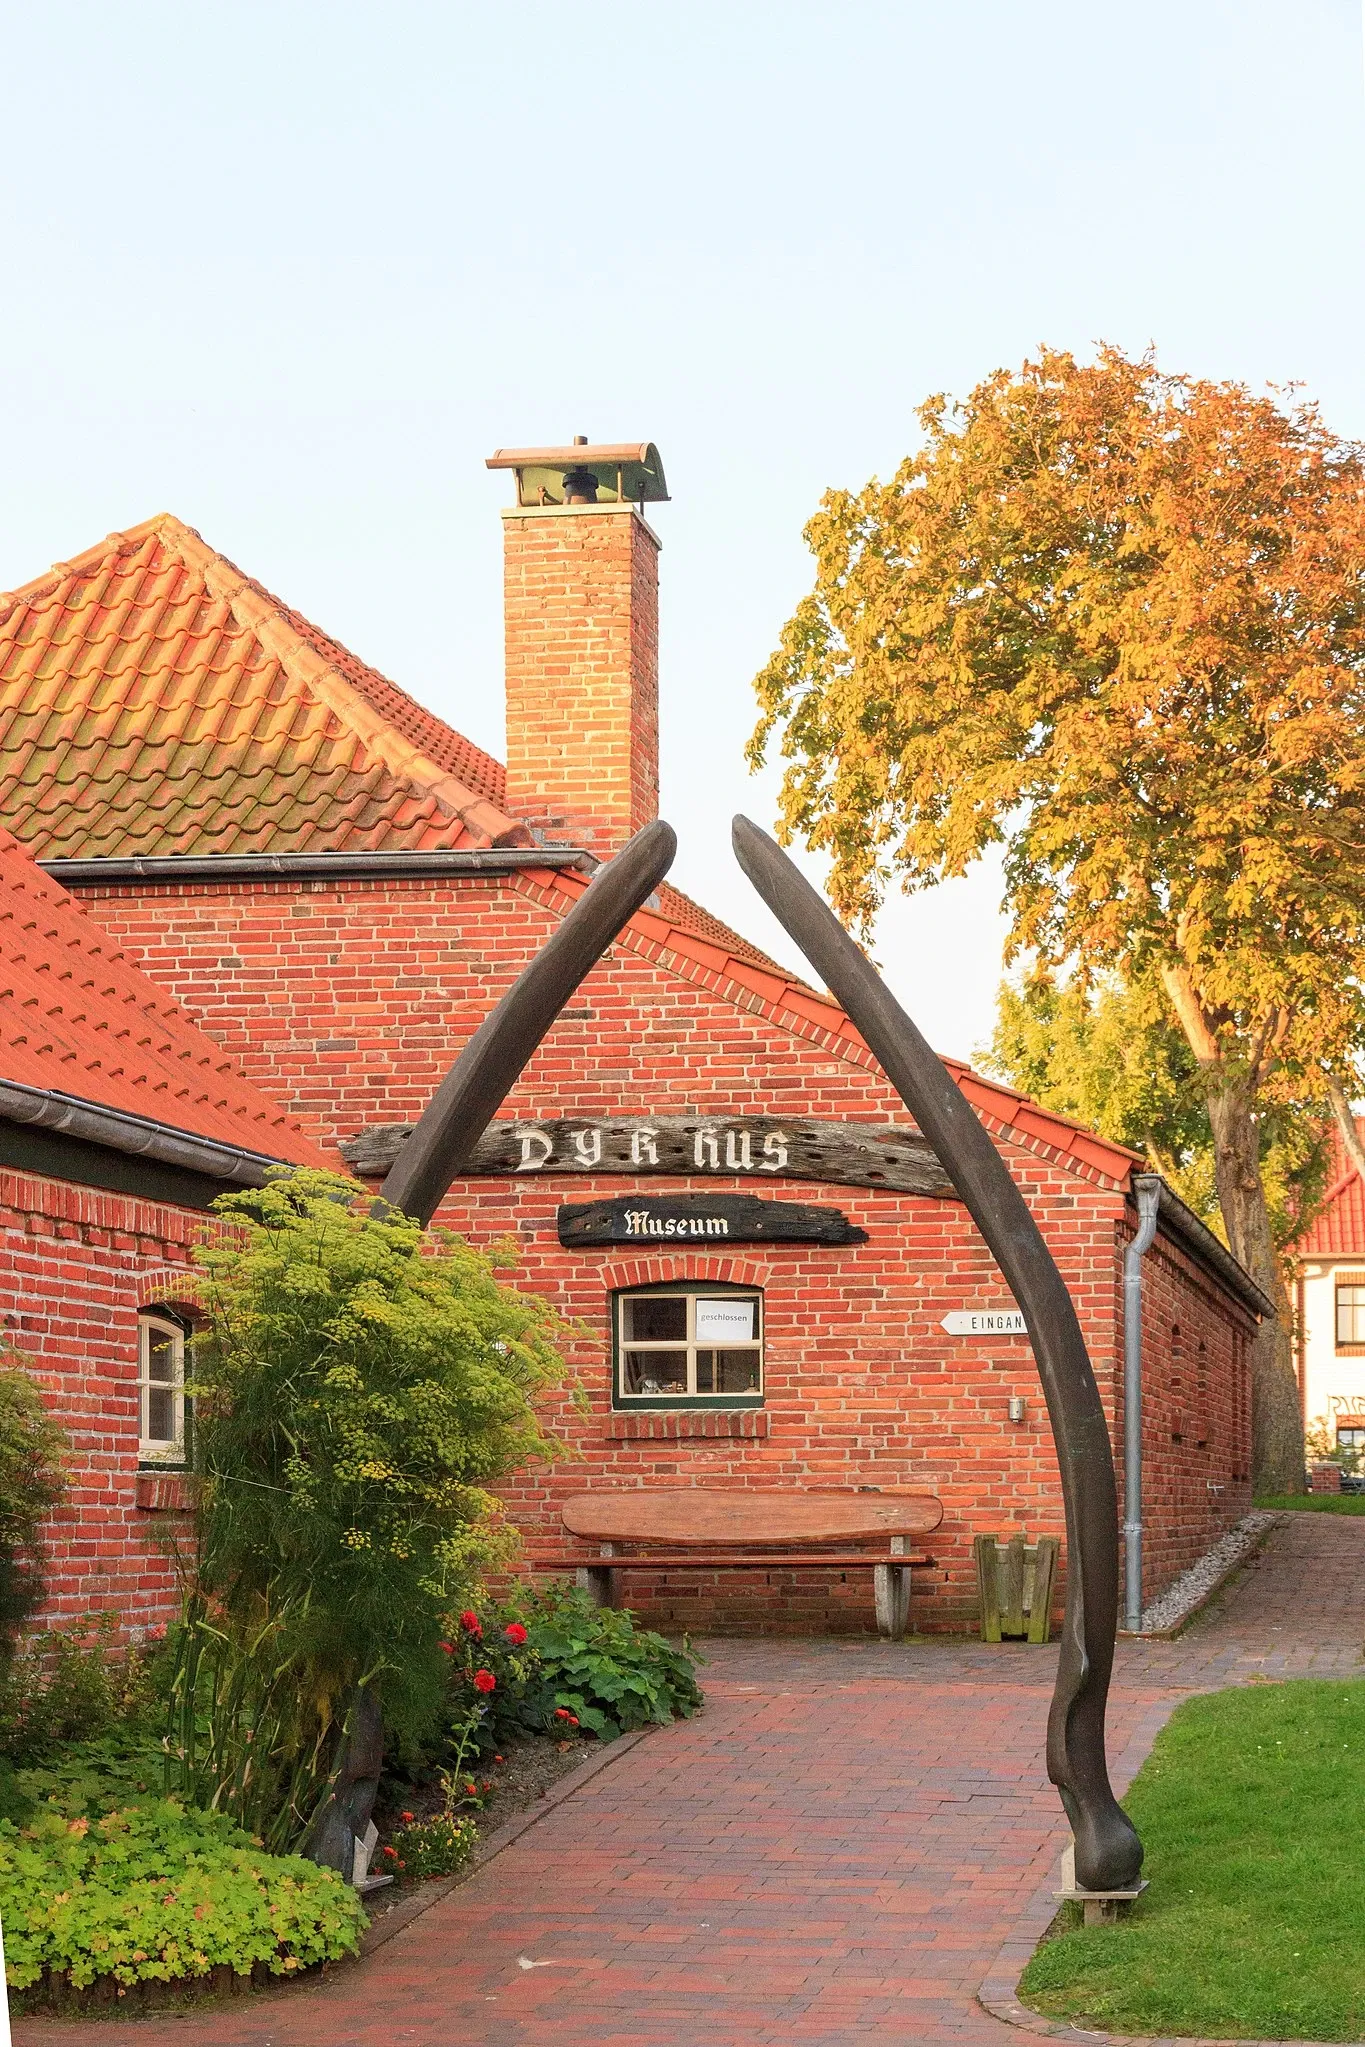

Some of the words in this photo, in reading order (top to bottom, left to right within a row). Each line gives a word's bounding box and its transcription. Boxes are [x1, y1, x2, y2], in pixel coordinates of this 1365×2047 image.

[623, 1209, 729, 1235] Museum
[700, 1313, 748, 1322] geschlossen
[971, 1316, 1022, 1329] EINGAN
